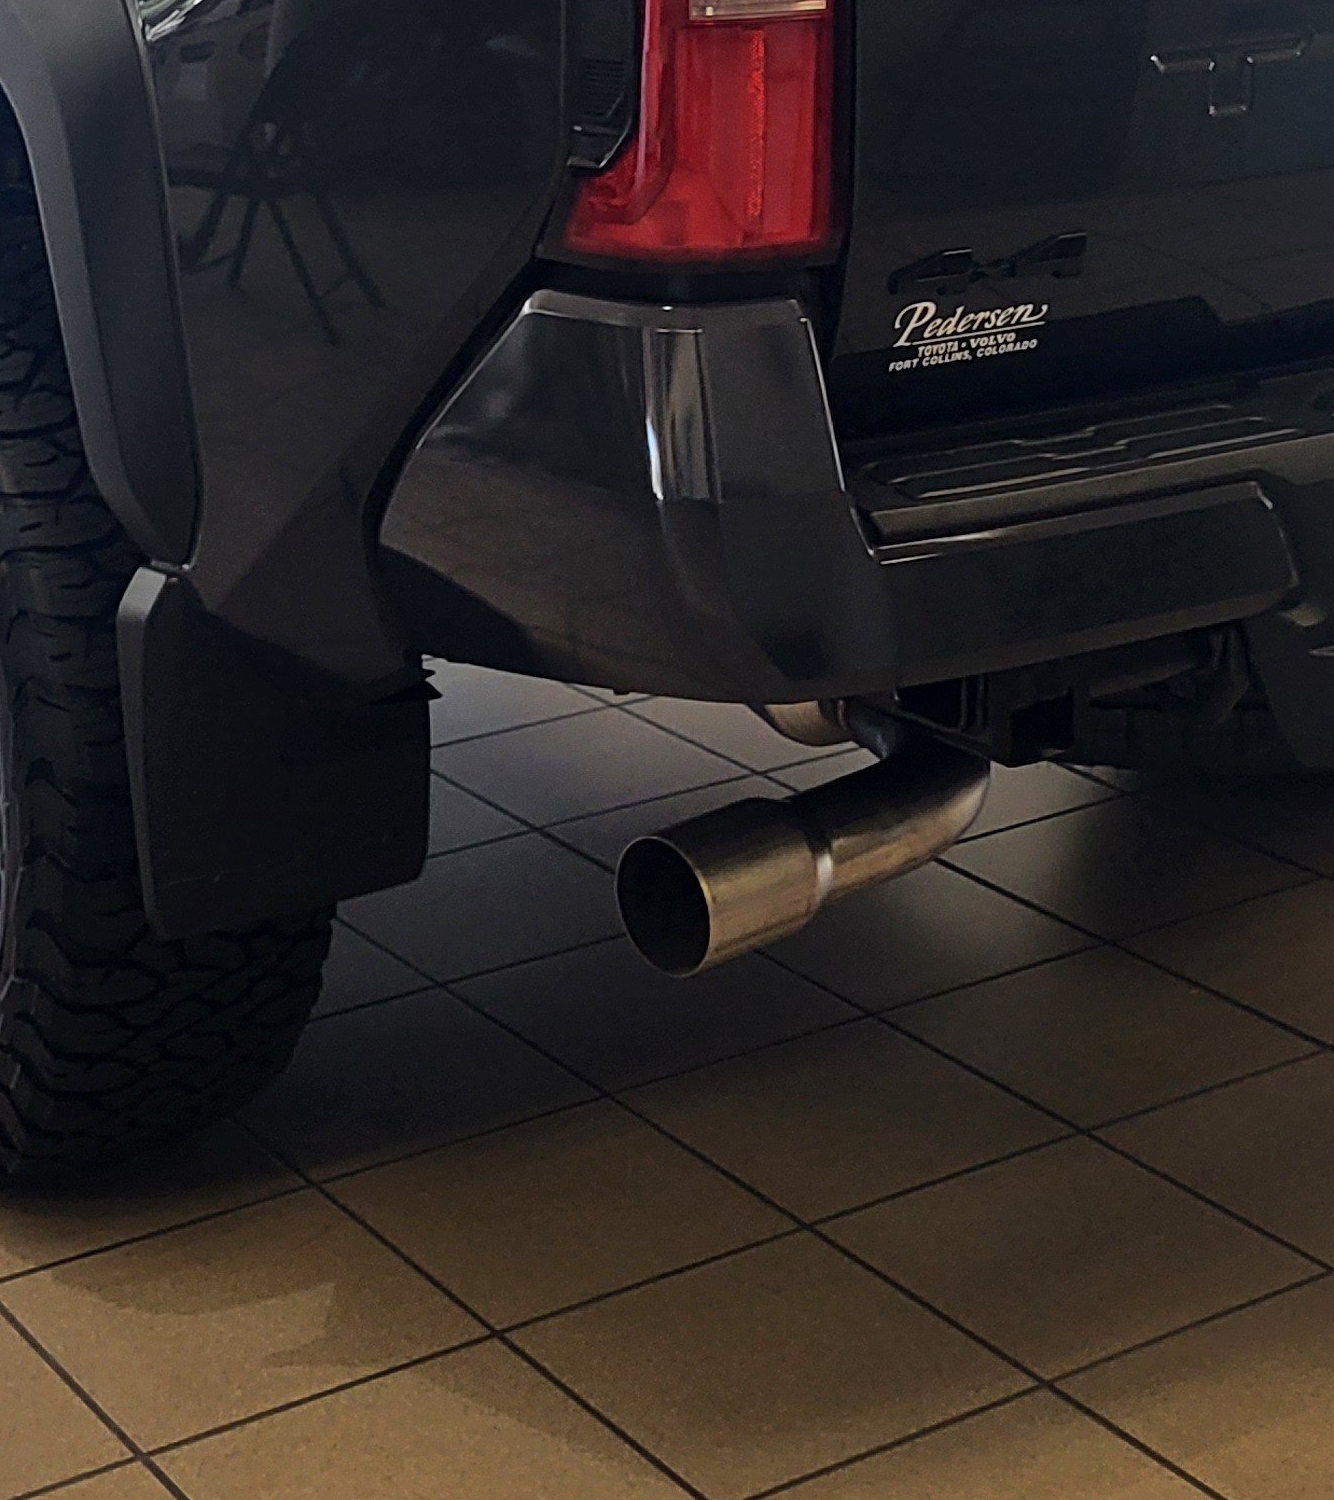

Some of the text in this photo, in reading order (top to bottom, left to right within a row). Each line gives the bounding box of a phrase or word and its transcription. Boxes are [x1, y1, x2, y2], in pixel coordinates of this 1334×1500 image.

[893, 301, 1048, 348] Pedersen
[888, 339, 1038, 373] FORT COLLINS, COLORADO
[917, 332, 1017, 358] TOYOTA VOLVO
